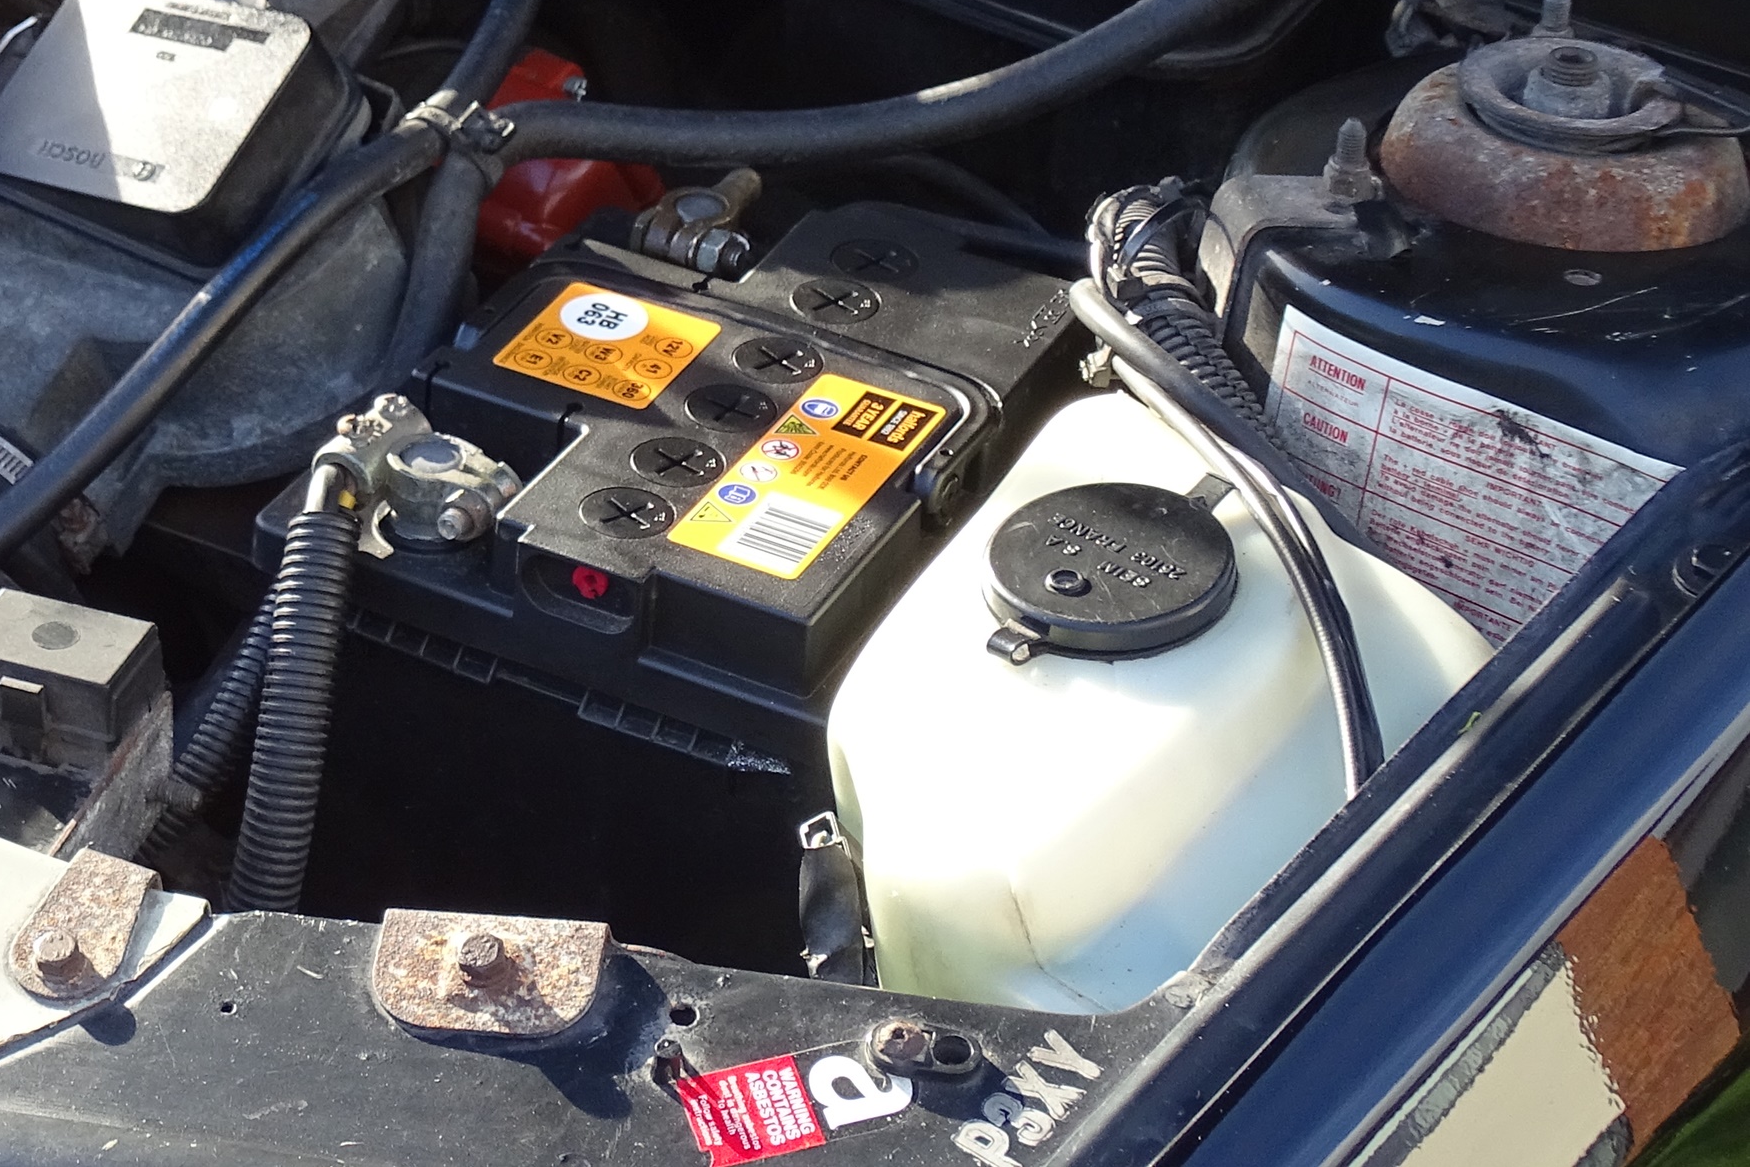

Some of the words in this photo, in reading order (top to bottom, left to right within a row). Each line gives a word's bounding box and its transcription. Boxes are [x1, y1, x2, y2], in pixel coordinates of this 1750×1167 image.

[577, 302, 602, 327] 063
[599, 309, 628, 330] HB
[546, 334, 566, 345] V2
[594, 347, 616, 361] W3
[662, 340, 683, 357] 12V
[526, 354, 544, 365] E1
[1310, 355, 1366, 391] ATTENTION
[573, 369, 592, 381] C2
[621, 382, 644, 399] 360
[1307, 380, 1359, 407] ALTERNATEUR
[852, 408, 880, 431] YEAR
[870, 402, 884, 411] 3
[887, 410, 927, 443] halfords
[1303, 413, 1349, 444] CAUTION
[1384, 453, 1398, 465] The
[1430, 474, 1454, 487] cable
[1482, 494, 1513, 510] should
[1486, 482, 1542, 507] IMPORTANT
[1411, 495, 1435, 511] being
[1439, 507, 1485, 530] connected
[1049, 512, 1127, 554] FRANCE
[1522, 529, 1552, 545] should
[1464, 534, 1490, 549] SEHR
[1494, 547, 1535, 568] WICHTIG
[1454, 601, 1513, 632] IMPORTANTE
[717, 1099, 726, 1110] to
[719, 1079, 732, 1101] dust
[730, 1106, 751, 1151] dangerous
[727, 1075, 747, 1116] Breathing
[741, 1113, 762, 1151] asbestos
[745, 1072, 786, 1146] ASBESTOS
[762, 1070, 801, 1140] CONTAINS
[778, 1066, 815, 1136] WARNING
[689, 1098, 713, 1146] instructions
[698, 1093, 713, 1121] Follow
[708, 1119, 723, 1146] safety
[721, 1108, 737, 1136] health
